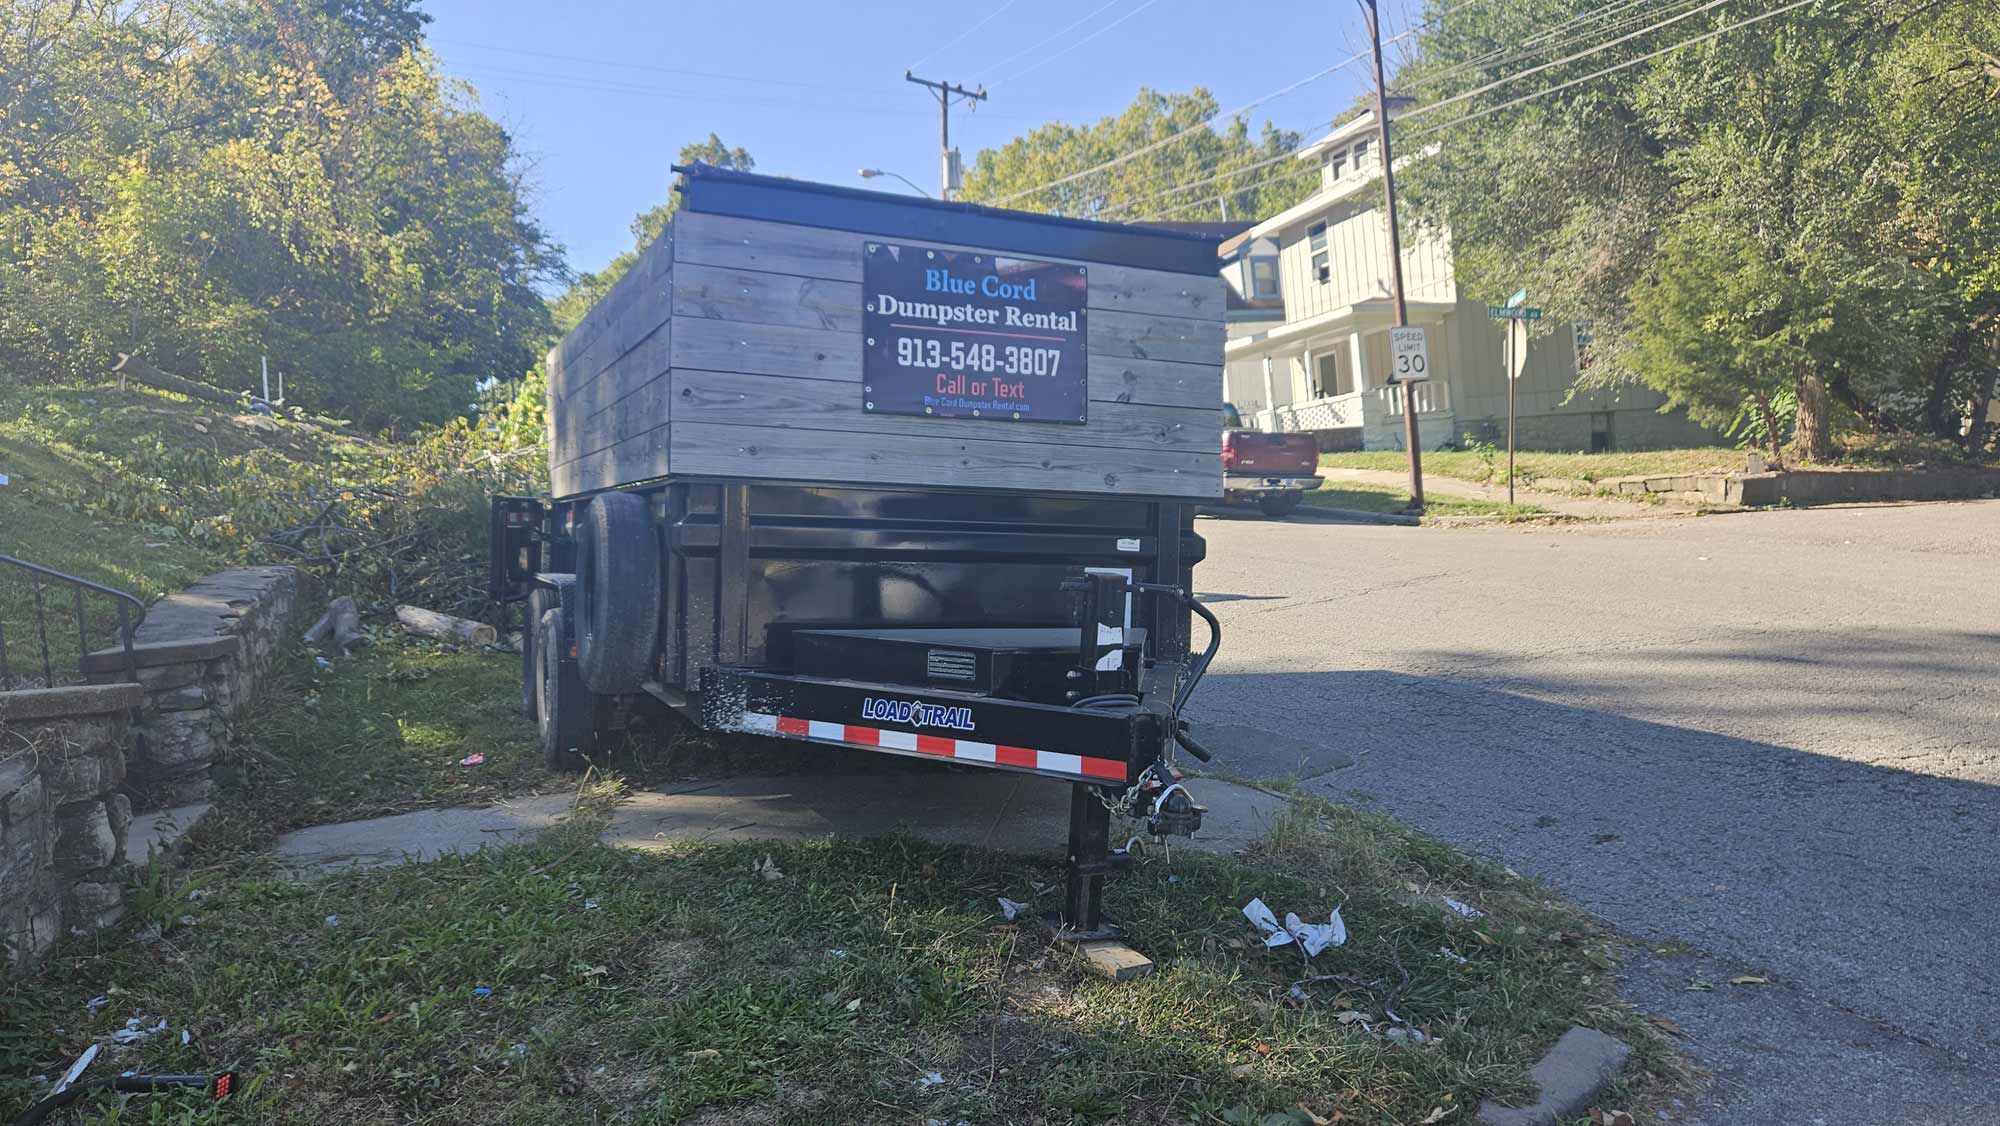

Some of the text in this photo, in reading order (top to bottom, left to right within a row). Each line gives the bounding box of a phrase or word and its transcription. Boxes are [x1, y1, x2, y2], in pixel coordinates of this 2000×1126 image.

[925, 269, 1037, 301] Blue Cord
[877, 294, 1078, 332] Dumpster Rental
[1394, 332, 1423, 342] SPEED
[1399, 343, 1421, 352] LIMIT
[897, 337, 1061, 377] 913-548-3807
[1398, 354, 1425, 373] 30
[936, 373, 1025, 398] Call or Text
[924, 395, 939, 406] Blue
[941, 397, 957, 407] Cord
[958, 398, 991, 409] Dumpster
[862, 698, 975, 730] LOAD TRAIL
